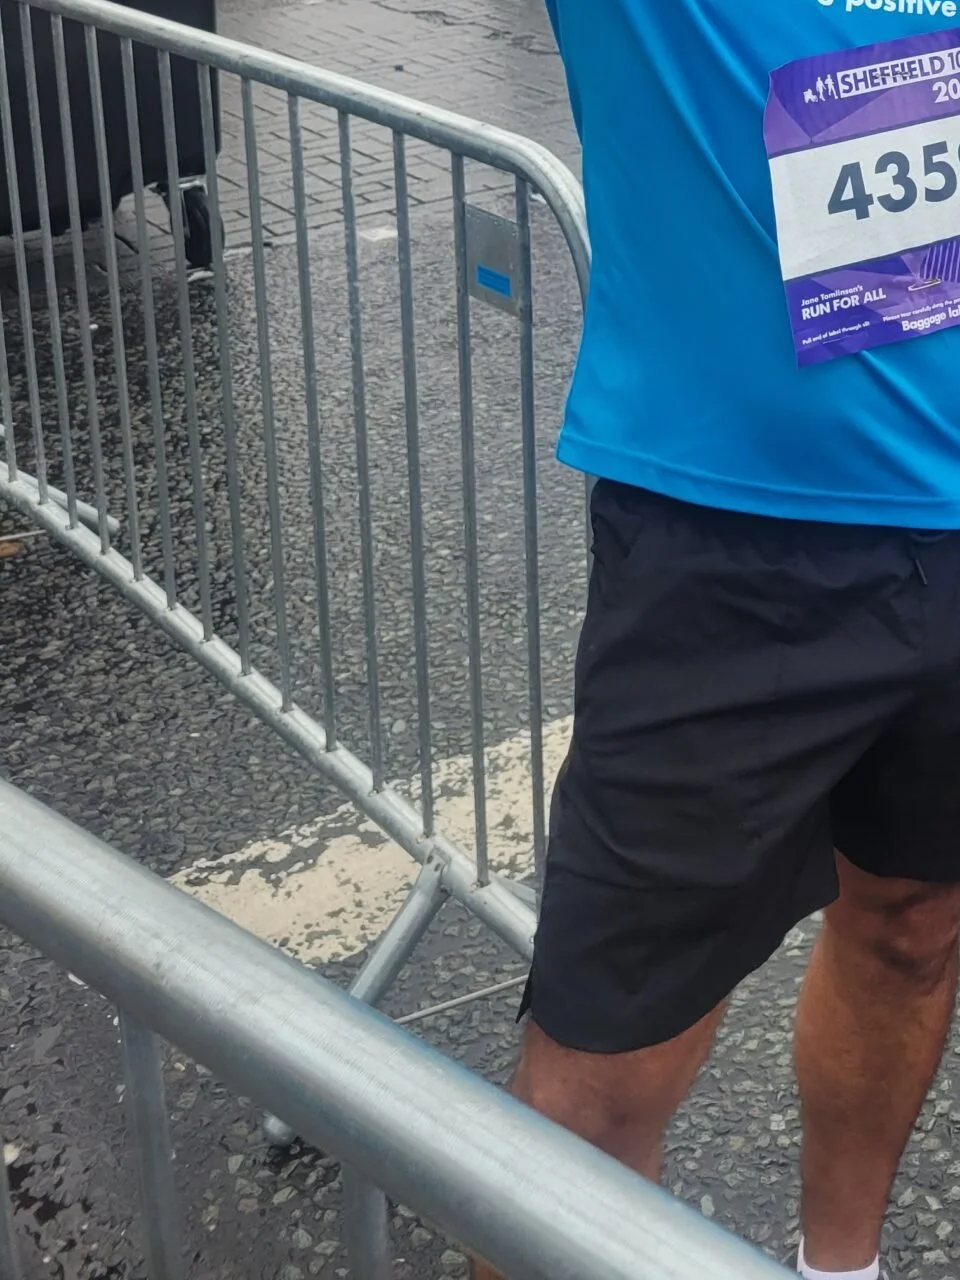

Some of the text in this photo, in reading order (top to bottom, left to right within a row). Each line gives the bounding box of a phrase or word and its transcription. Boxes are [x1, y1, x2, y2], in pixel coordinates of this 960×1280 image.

[840, 55, 946, 95] SHEFFIELD
[801, 284, 864, 307] Jane Tomlinson's
[801, 287, 887, 321] RUN FOR ALL
[901, 311, 947, 332] Baggage
